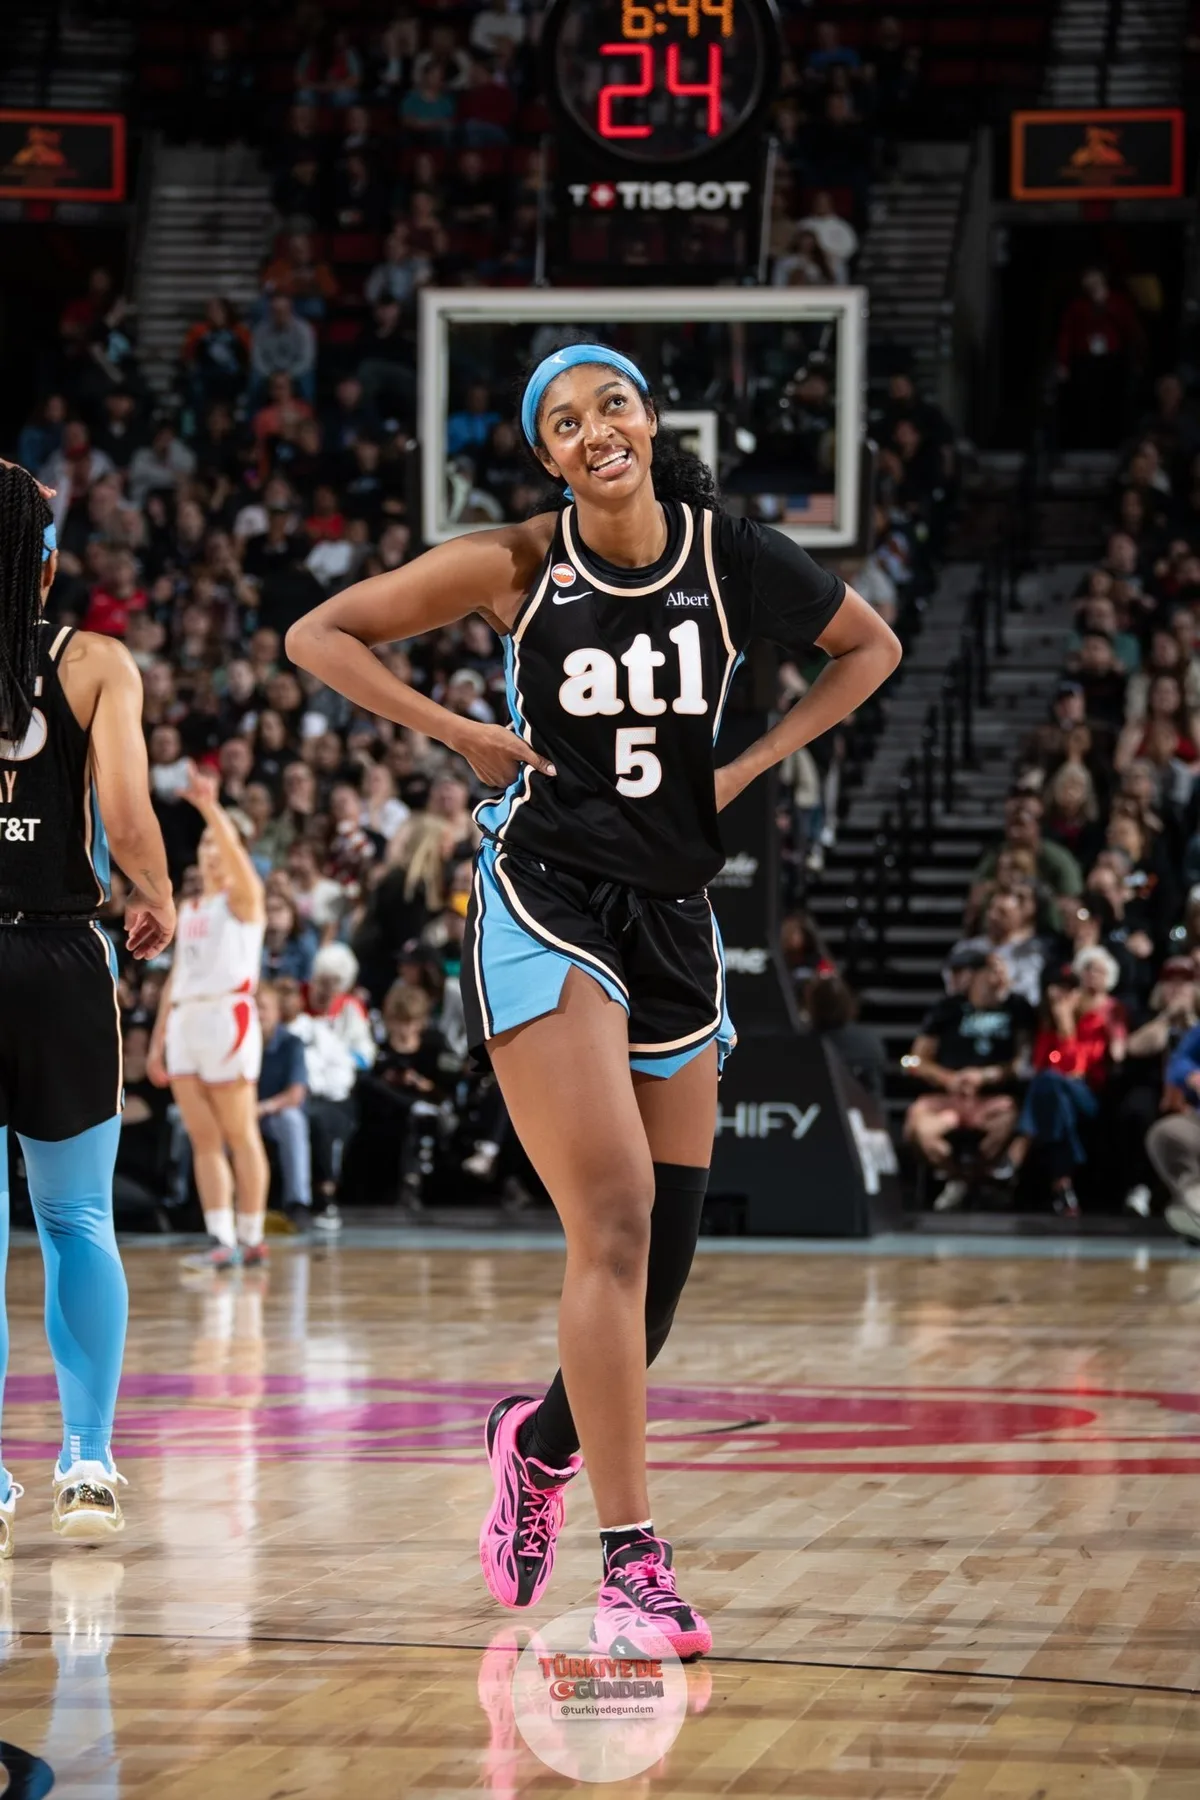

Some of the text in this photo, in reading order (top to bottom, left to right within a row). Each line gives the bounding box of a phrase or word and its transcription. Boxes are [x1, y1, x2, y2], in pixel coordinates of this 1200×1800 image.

[597, 42, 723, 138] 24
[617, 181, 749, 210] TISSOT
[666, 591, 709, 606] Albert
[559, 620, 708, 716] atl
[0, 770, 17, 803] Y
[615, 727, 662, 798] 5
